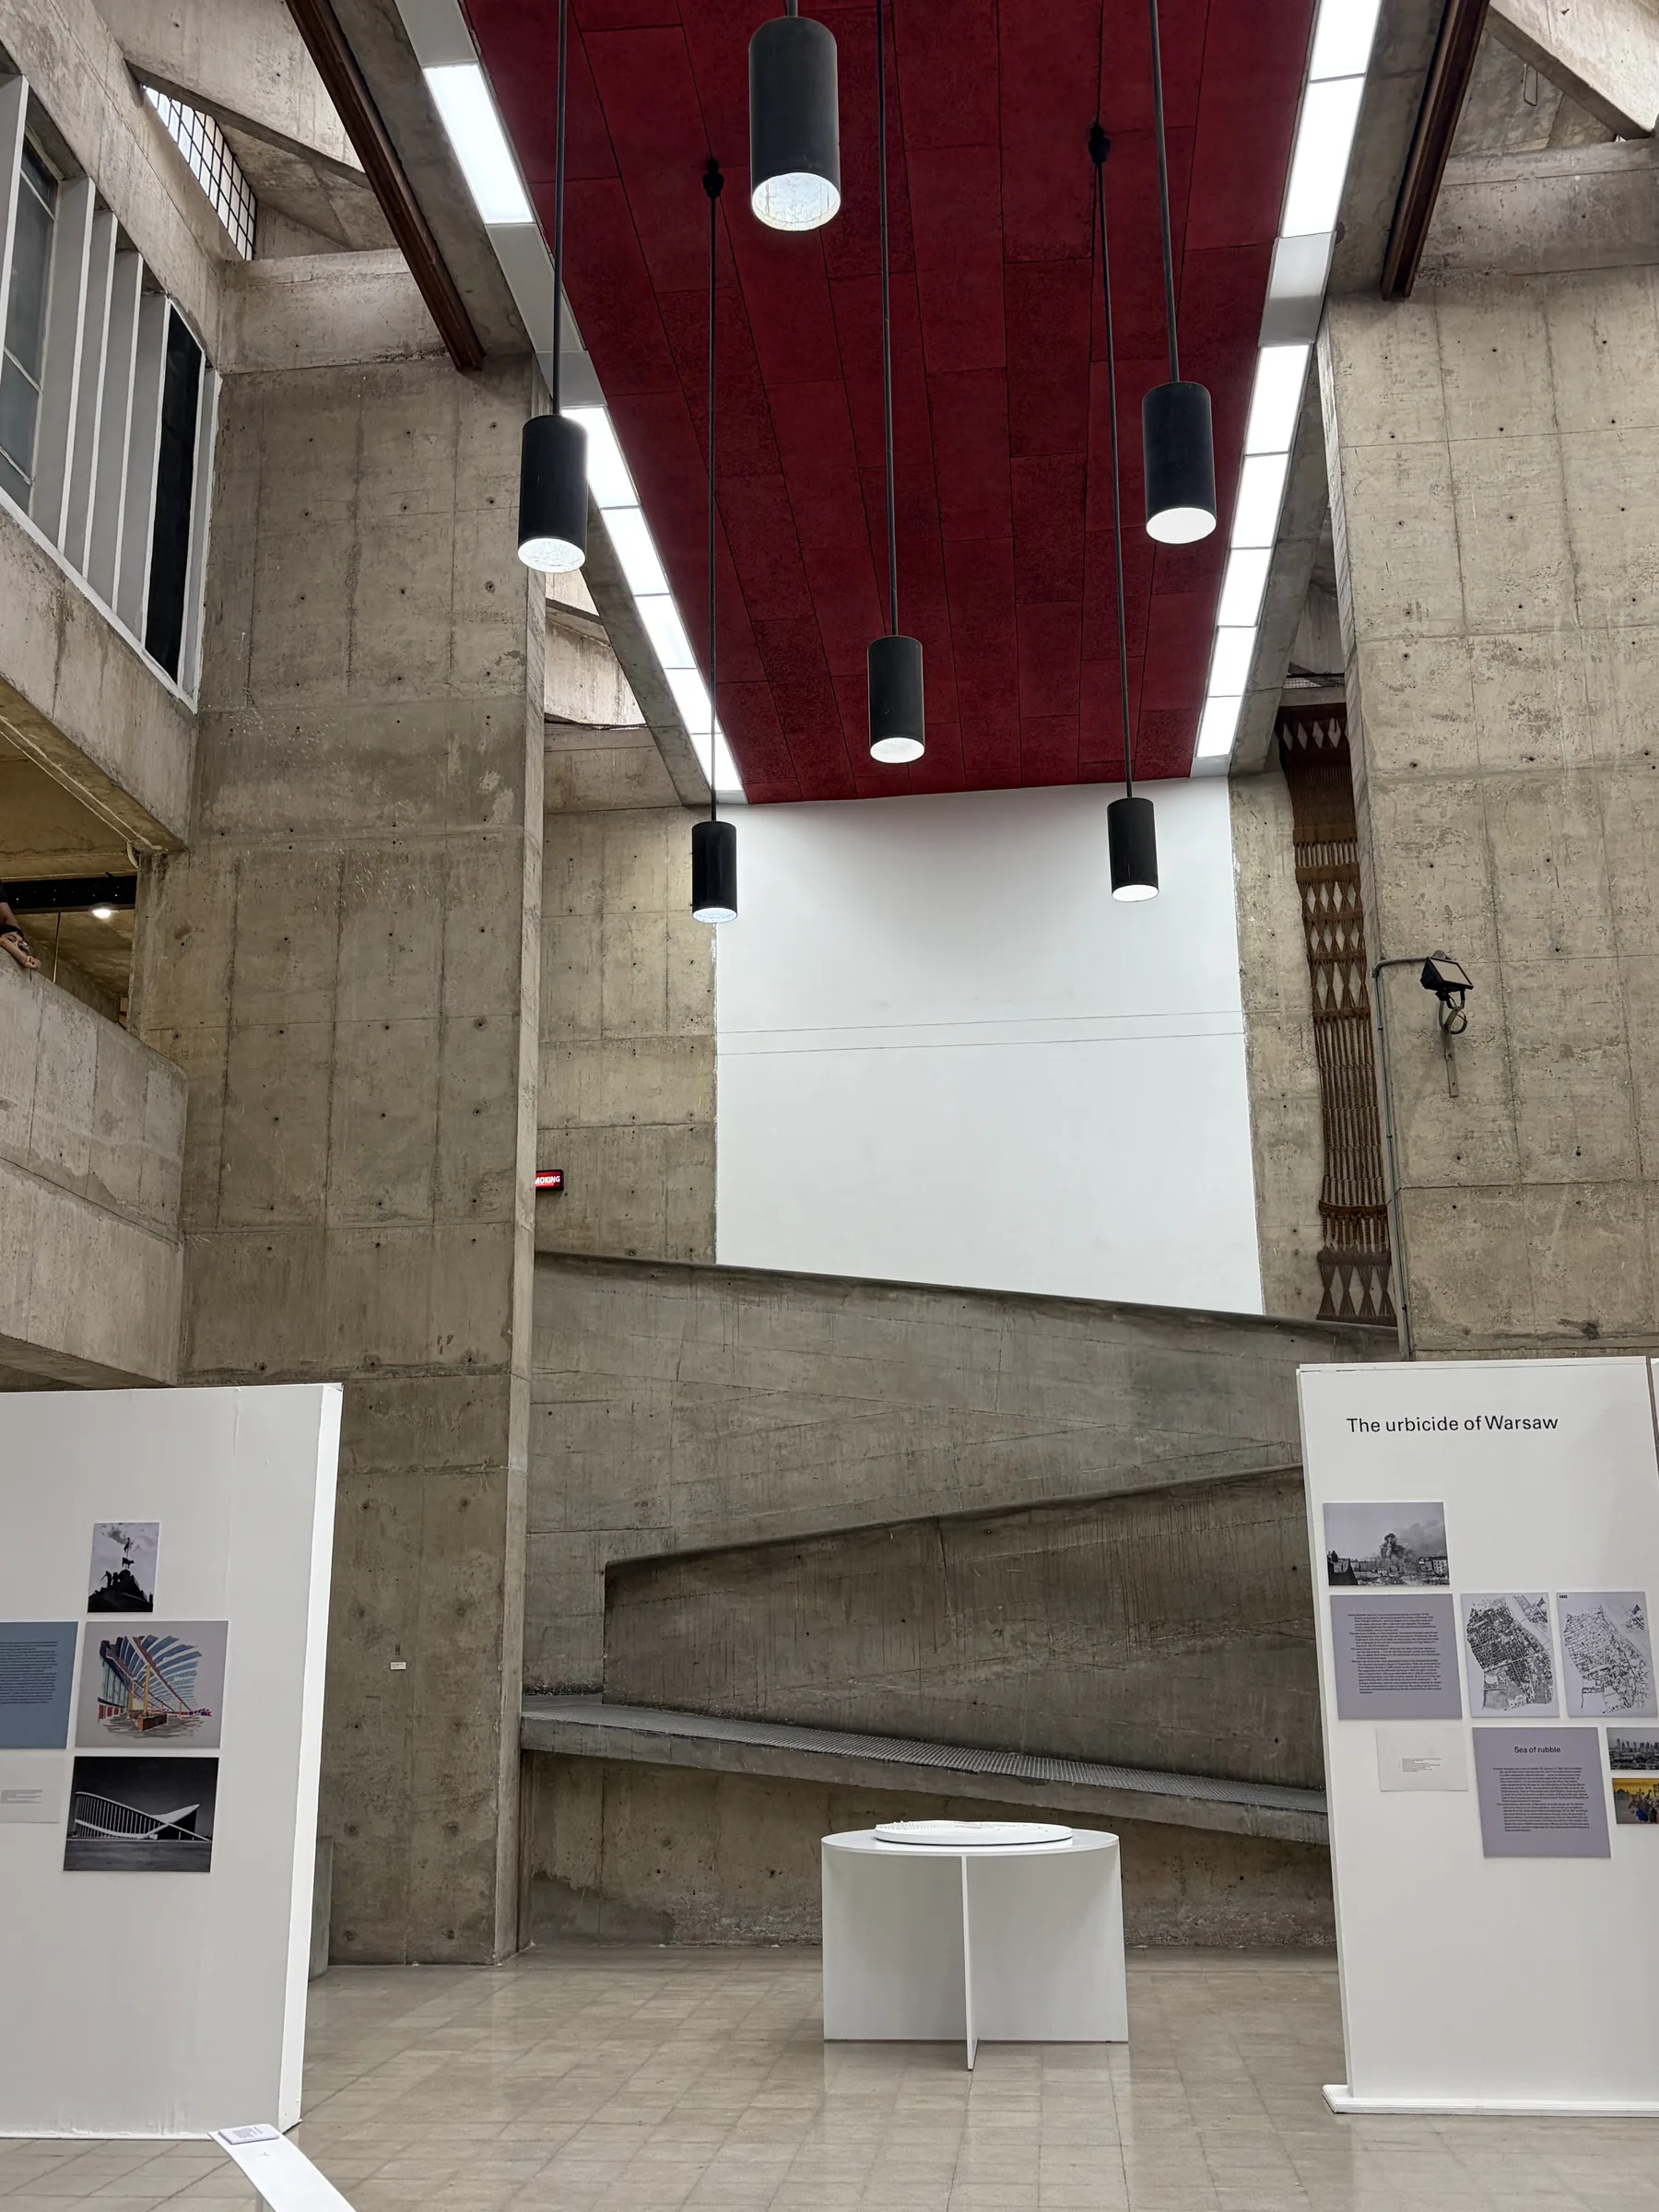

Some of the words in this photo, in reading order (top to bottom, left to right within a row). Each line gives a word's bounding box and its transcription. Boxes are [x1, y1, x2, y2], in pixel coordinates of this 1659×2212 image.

[1347, 1418, 1381, 1432] The
[1385, 1416, 1459, 1431] urbicide
[1464, 1415, 1481, 1430] of
[1484, 1415, 1559, 1430] Warsaw
